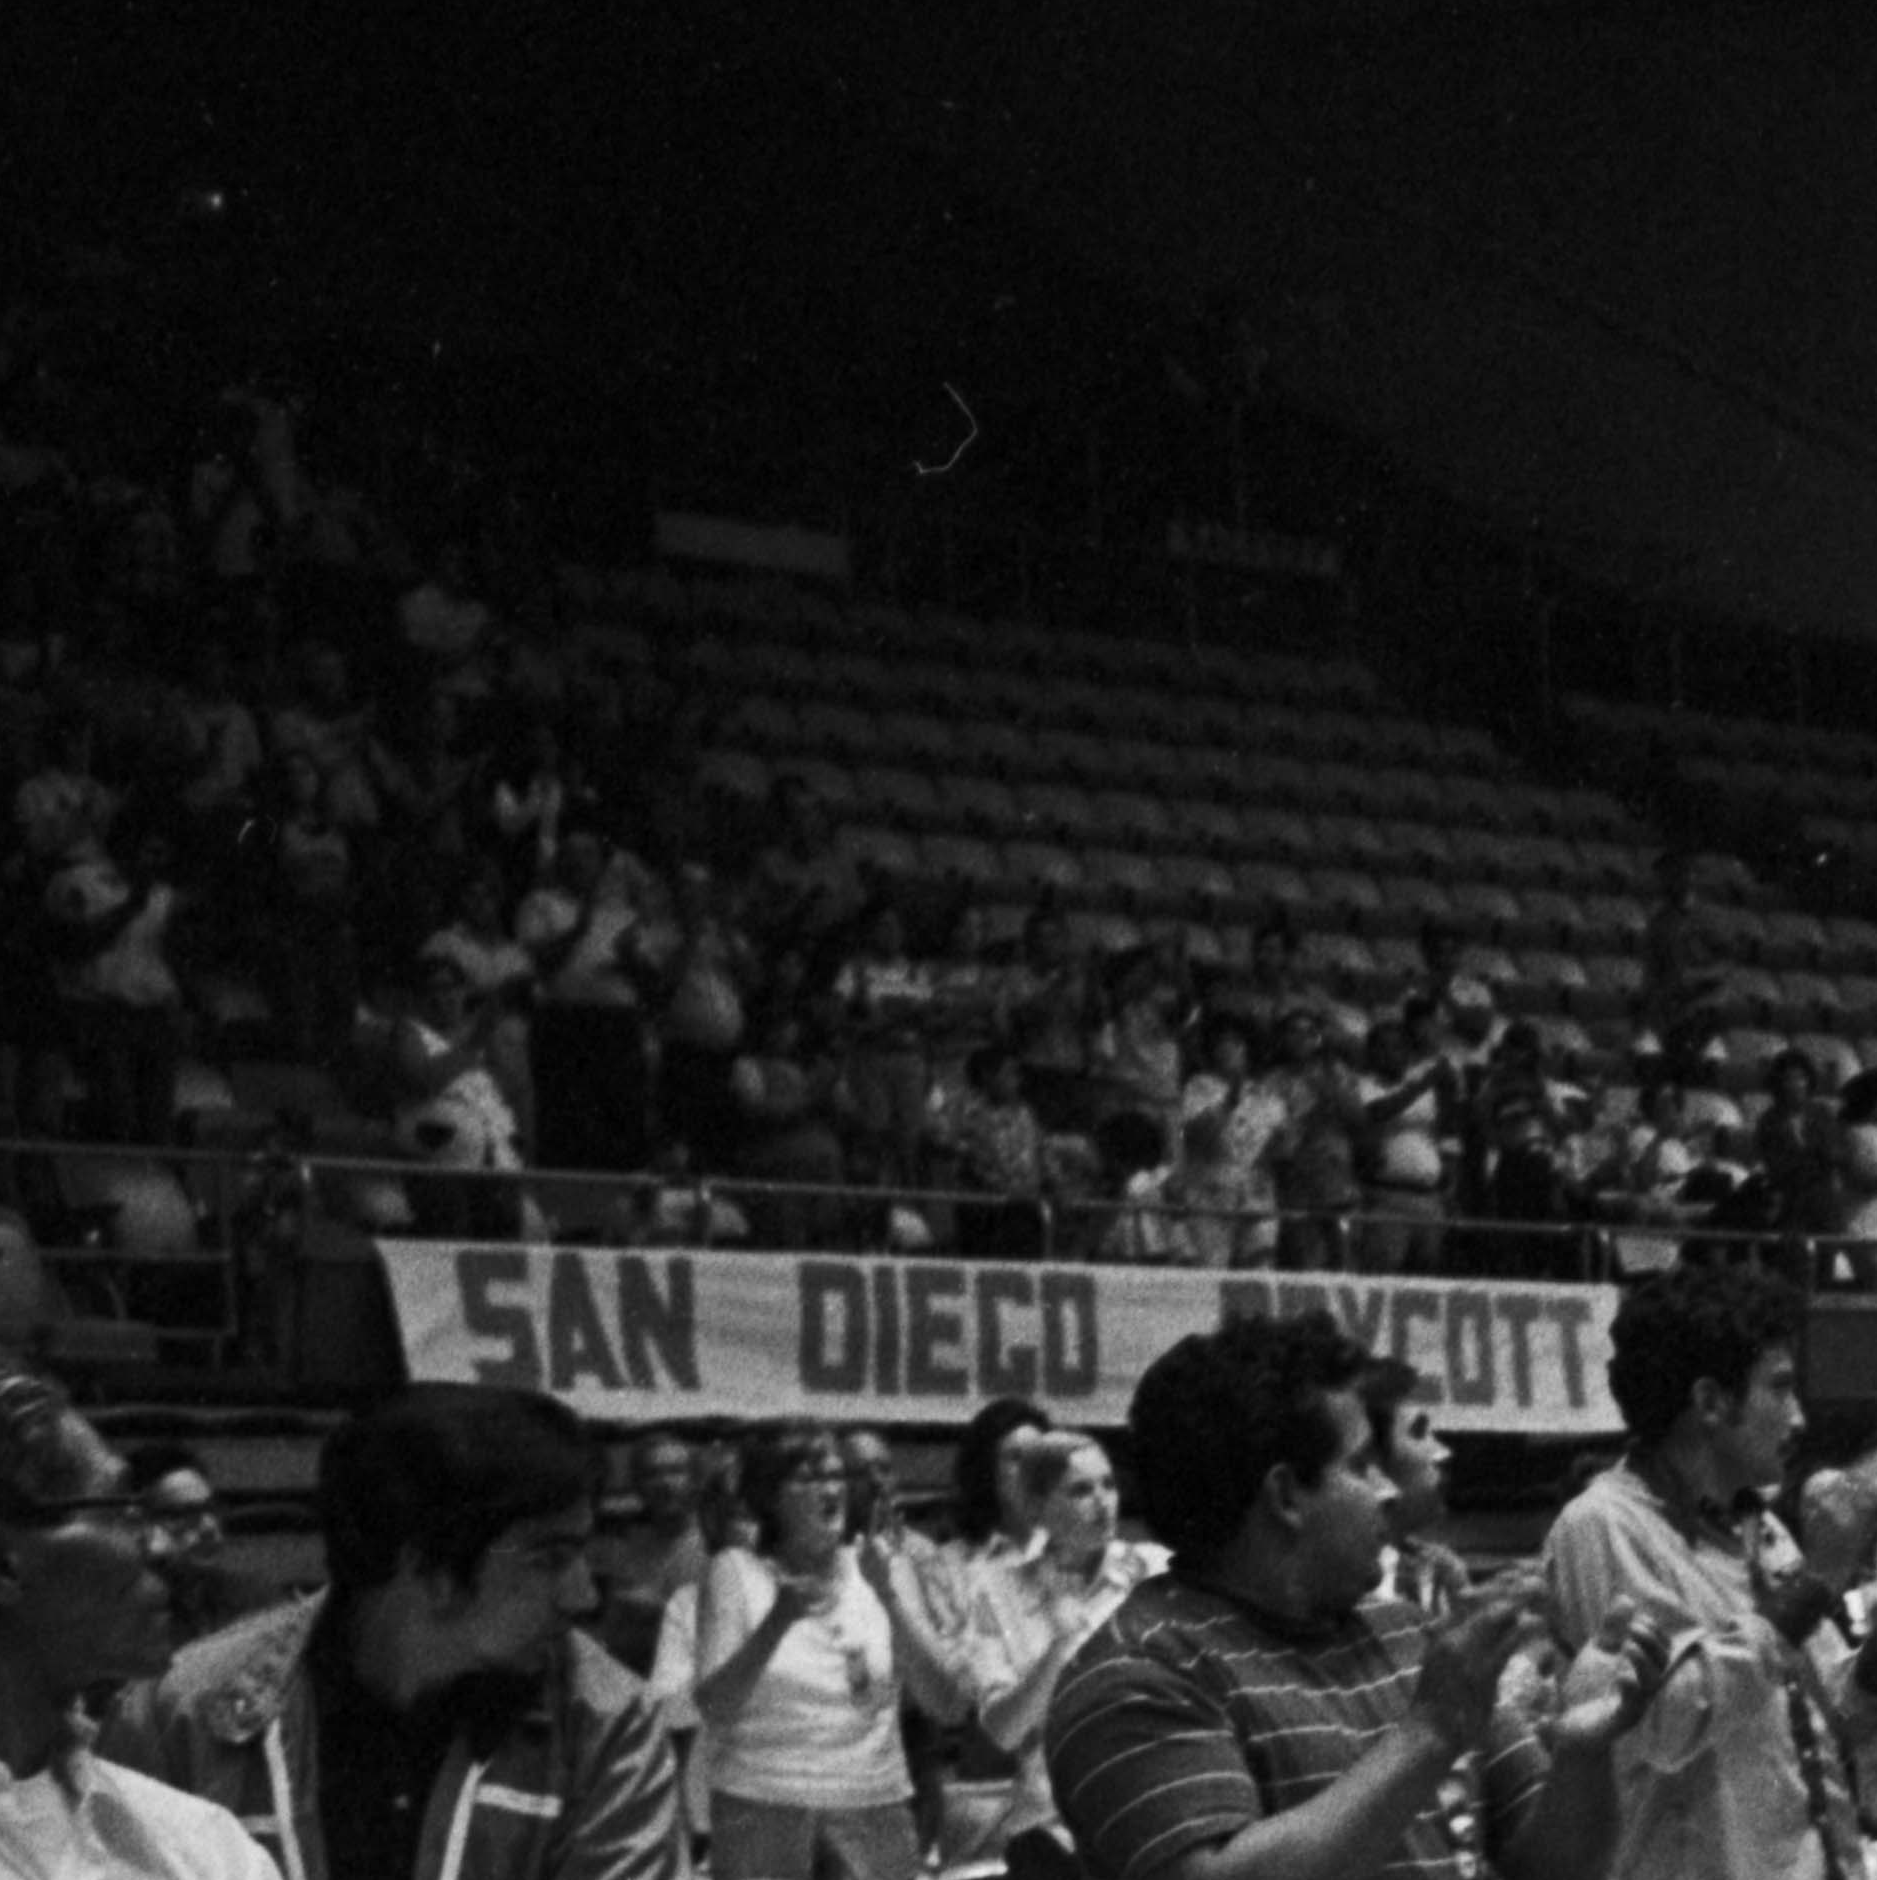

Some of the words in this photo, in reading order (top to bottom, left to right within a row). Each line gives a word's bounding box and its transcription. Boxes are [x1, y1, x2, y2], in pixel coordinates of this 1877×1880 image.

[455, 1252, 701, 1391] SAN
[799, 1262, 1099, 1396] DIEGO
[1219, 1280, 1592, 1407] YCOTT
